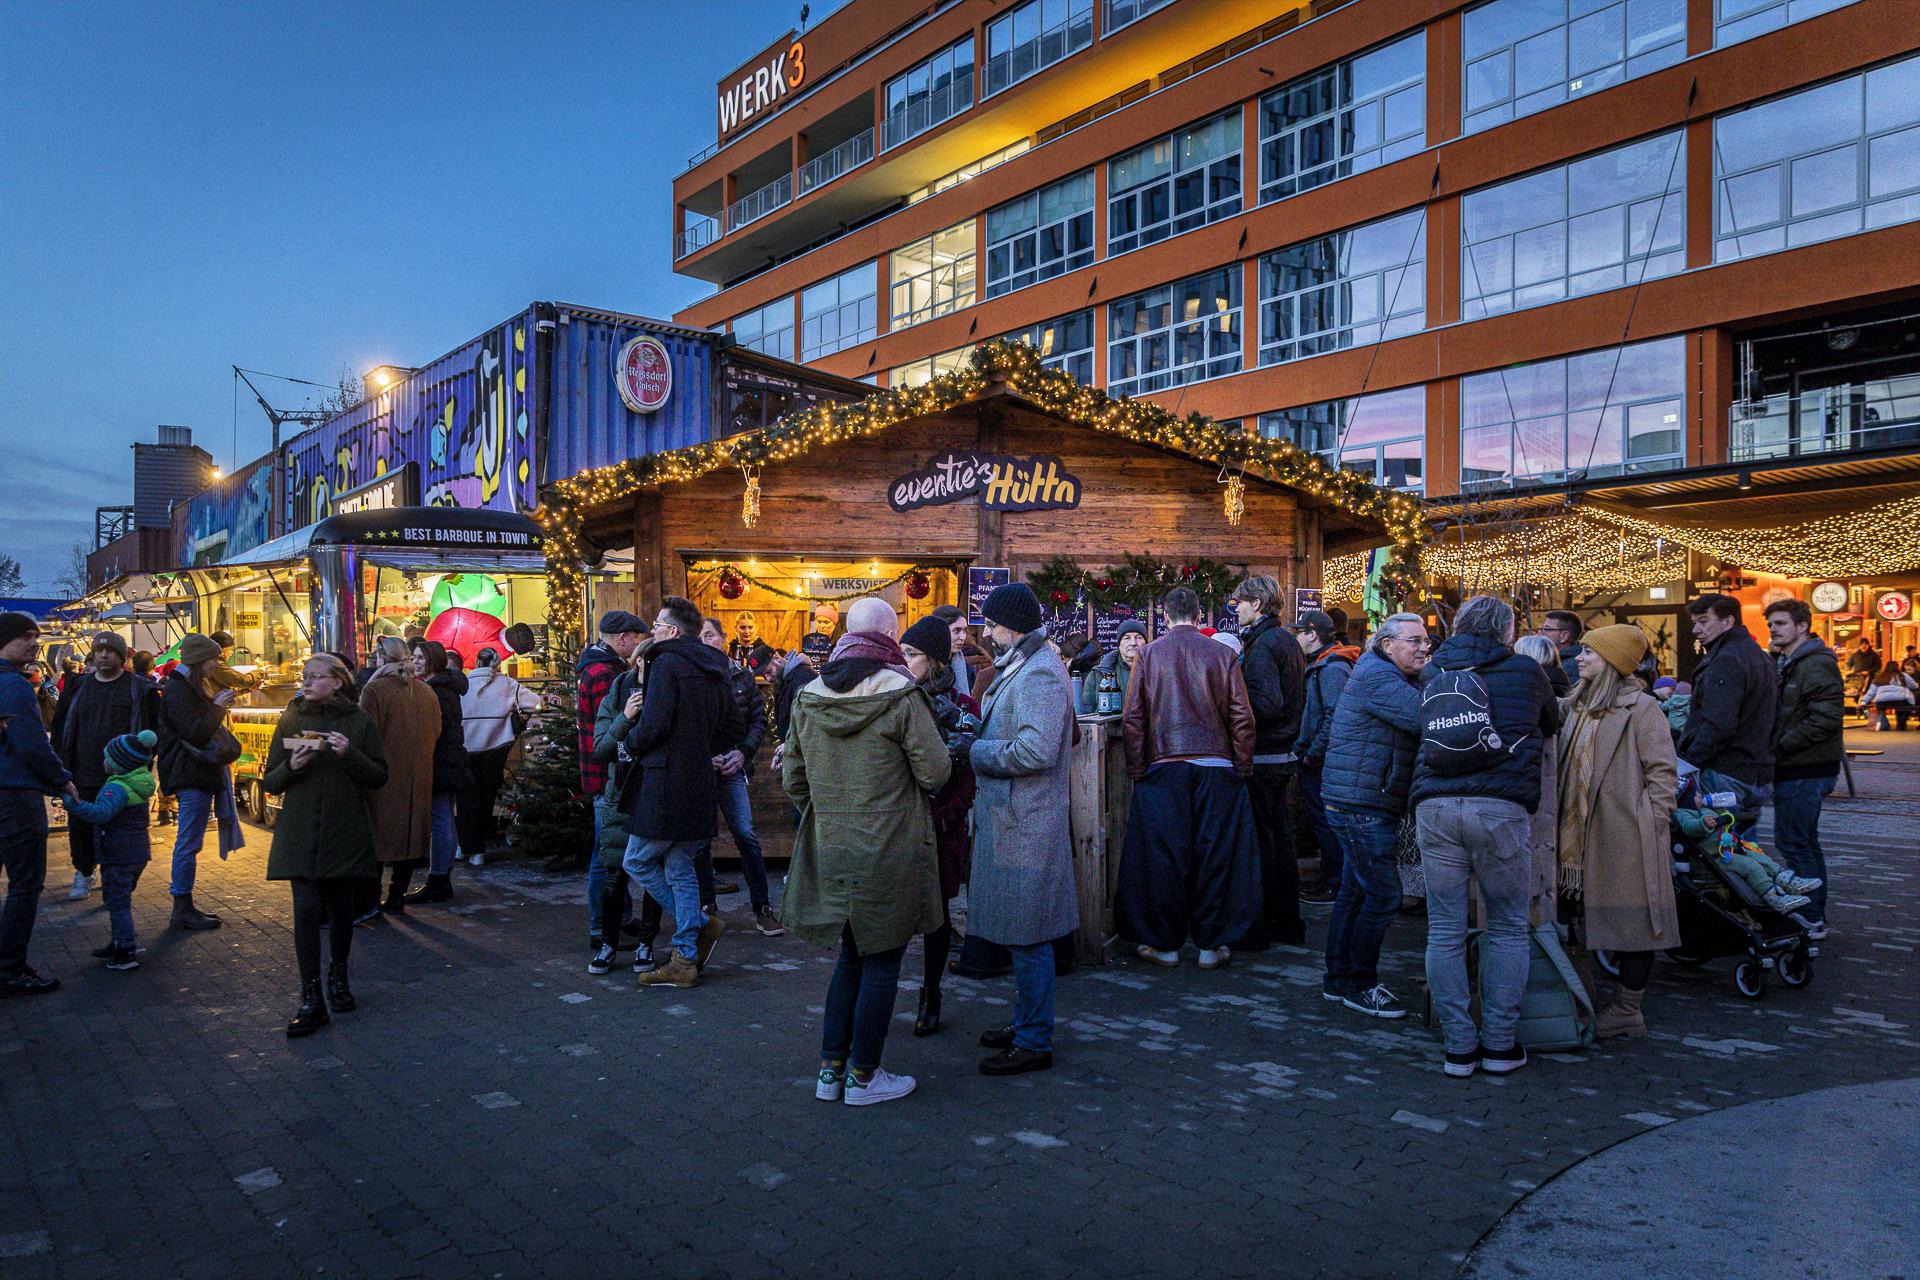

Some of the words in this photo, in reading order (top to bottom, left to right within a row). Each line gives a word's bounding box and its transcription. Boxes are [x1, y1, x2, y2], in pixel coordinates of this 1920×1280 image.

[404, 527, 432, 540] BEST
[435, 529, 483, 543] BARBQUE
[486, 531, 497, 544] IN
[500, 532, 528, 545] TOWN
[1427, 711, 1490, 731] #Hashbag
